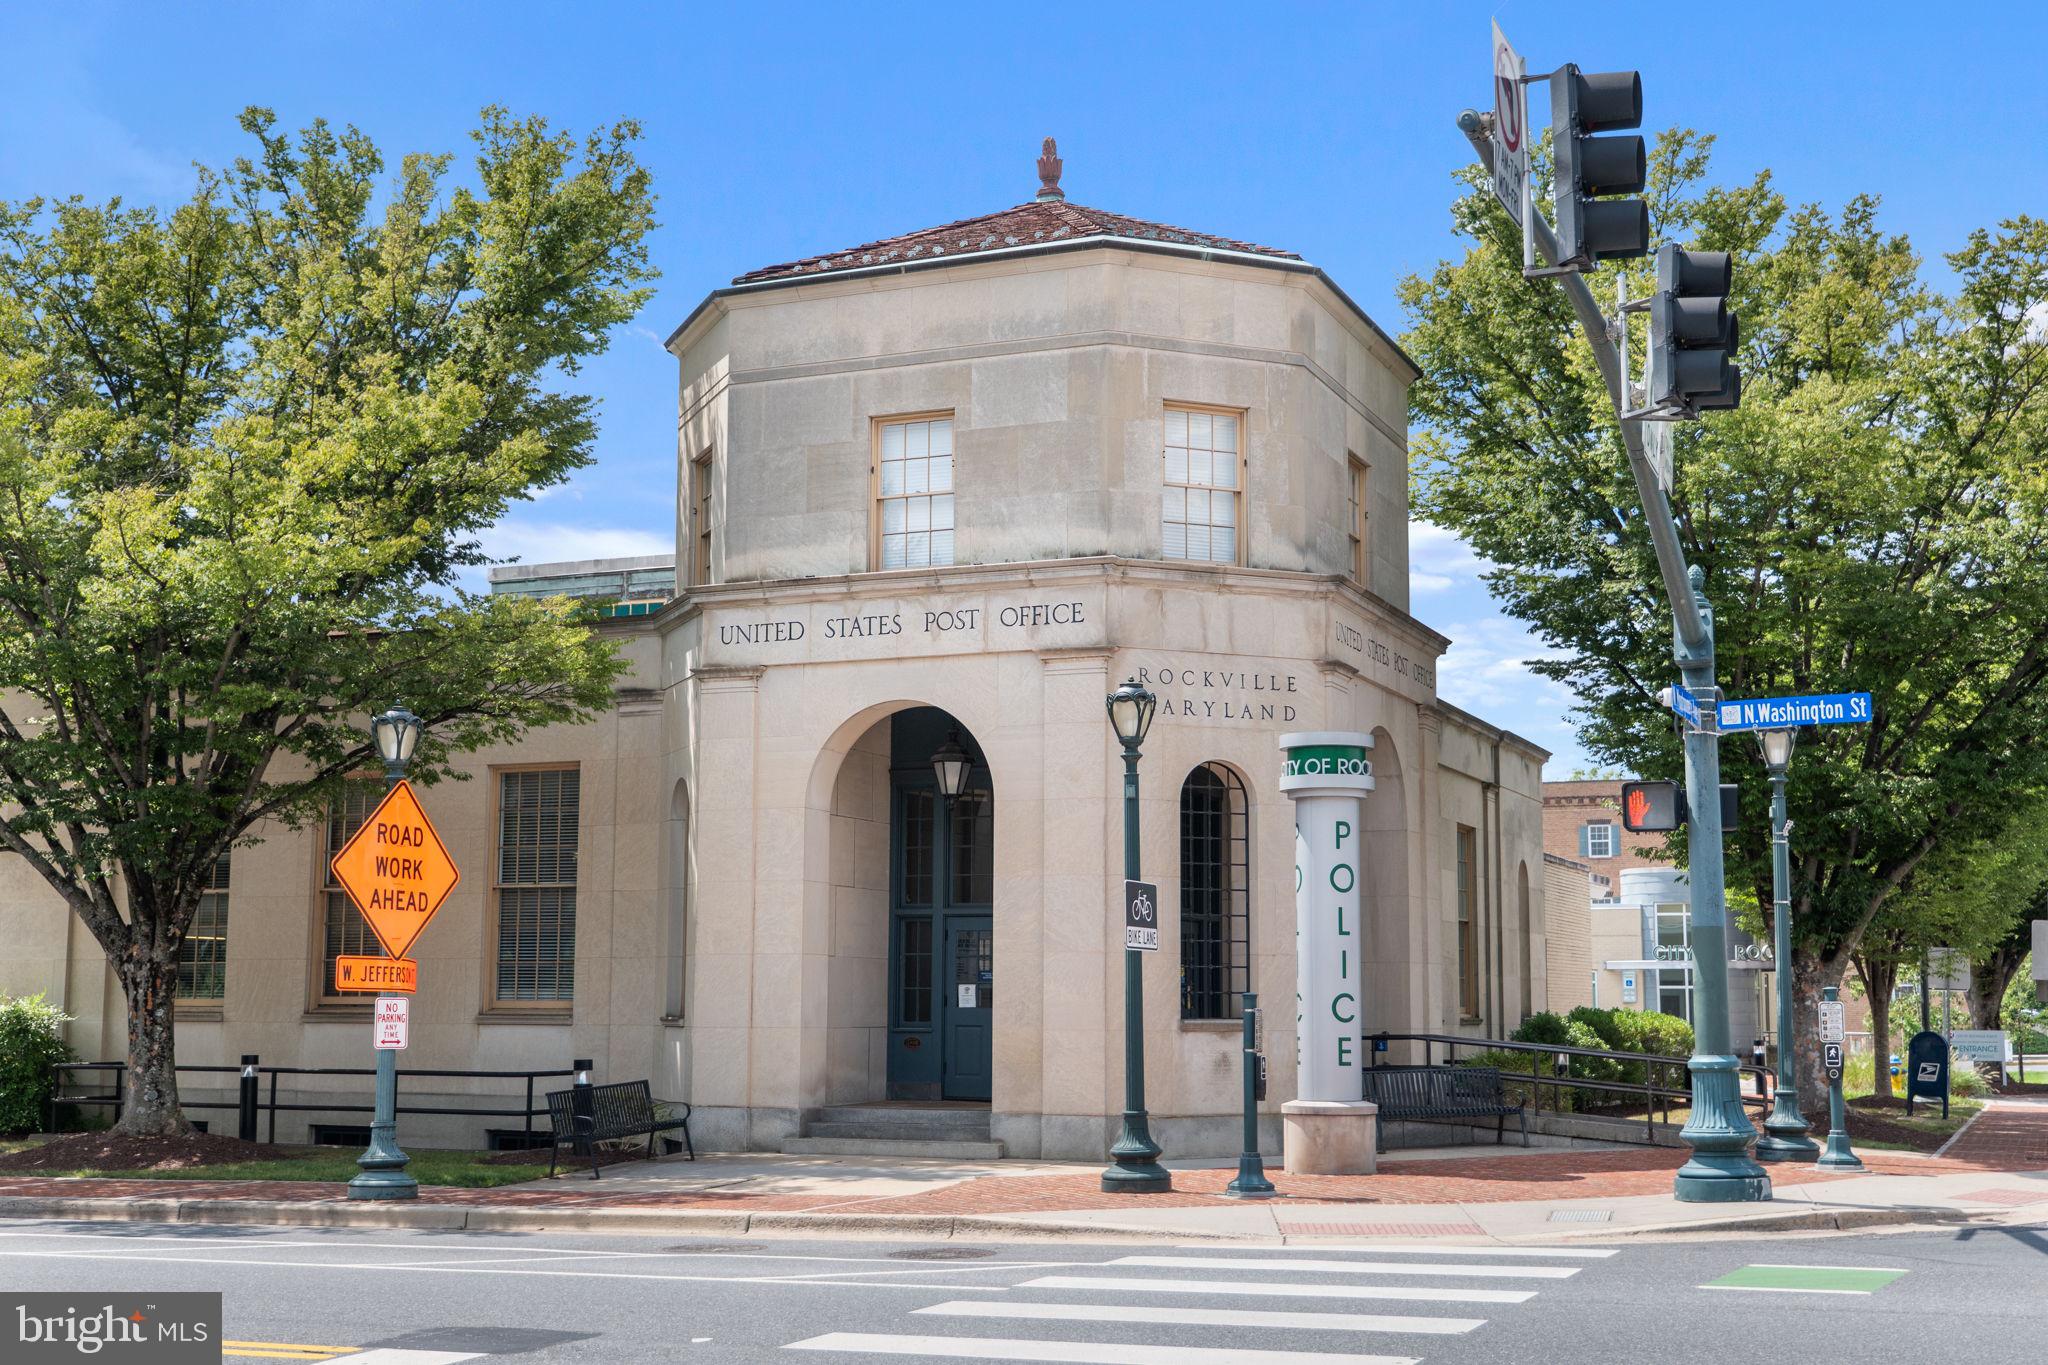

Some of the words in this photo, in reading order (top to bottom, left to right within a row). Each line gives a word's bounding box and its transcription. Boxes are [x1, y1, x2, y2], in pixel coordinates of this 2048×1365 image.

[719, 620, 805, 645] UNITED
[824, 614, 902, 639] STATES
[923, 608, 980, 633] POST
[999, 602, 1085, 627] OFFICE
[1335, 620, 1363, 652] UNITED
[1367, 638, 1390, 667] STATES
[1393, 652, 1409, 677] POST
[1413, 663, 1433, 689] OFFICE
[1138, 667, 1298, 692] ROCKVILLE
[1161, 699, 1297, 722] ARYLAND
[1850, 697, 1867, 718] St
[1304, 758, 1331, 775] OF
[376, 822, 424, 848] ROAD
[375, 855, 424, 880] WORK
[369, 888, 429, 912] AHEAD
[1128, 929, 1142, 944] BIKE
[1143, 931, 1157, 946] LANE
[1329, 820, 1356, 1067] POLICE
[1653, 944, 1693, 961] CITY
[343, 965, 355, 982] W.
[377, 1013, 406, 1023] PARKING
[386, 1003, 398, 1012] NO
[1958, 1045, 1999, 1053] ENTRANCE
